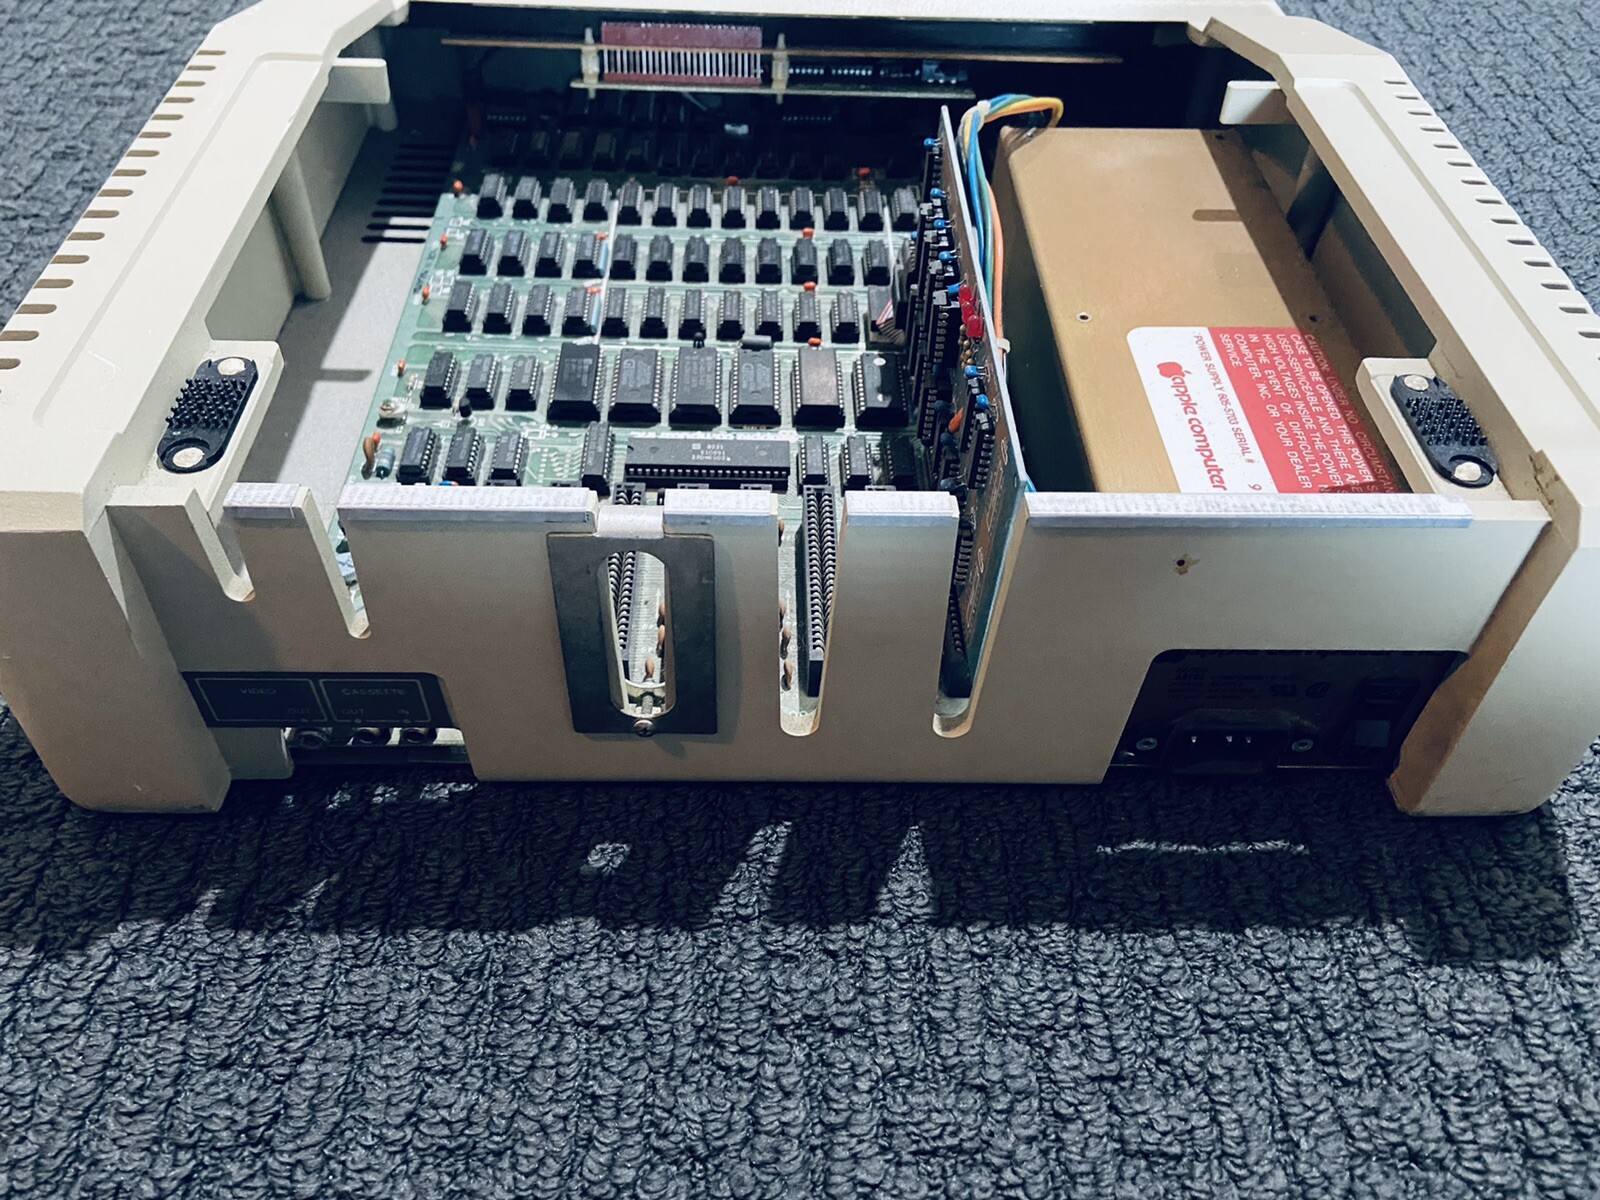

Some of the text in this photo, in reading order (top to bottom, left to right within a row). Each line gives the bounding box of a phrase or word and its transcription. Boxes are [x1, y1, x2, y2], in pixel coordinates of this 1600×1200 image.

[1247, 333, 1259, 342] IN
[1255, 348, 1270, 363] THE
[1264, 369, 1285, 396] EVENT
[1279, 402, 1294, 414] OF
[1290, 333, 1308, 354] CASE
[1302, 356, 1315, 368] TO
[1308, 370, 1322, 381] BE
[1171, 377, 1226, 490] apple computer
[1193, 335, 1211, 361] POWER
[1204, 363, 1224, 391] SUPPLY
[1231, 427, 1251, 456] SERIAL
[1262, 333, 1278, 353] HIGH
[1273, 355, 1301, 398] VOLTAGES
[1294, 400, 1316, 429] INSIDE
[1309, 431, 1326, 450] THE
[1319, 452, 1343, 486] POWER
[1276, 334, 1322, 412] USER-SERVICEABLE
[1316, 415, 1333, 435] AND
[1328, 438, 1351, 468] THERE
[1344, 473, 1362, 492] ARE
[1336, 423, 1354, 444] THIS
[1265, 404, 1280, 417] OR
[1274, 421, 1293, 446] YOUR
[1286, 451, 1312, 488] DEALER
[1344, 410, 1358, 423] NO
[1355, 431, 1393, 492] CIRCUMSTAN
[1347, 447, 1373, 481] POWER
[341, 705, 364, 715] OUT
